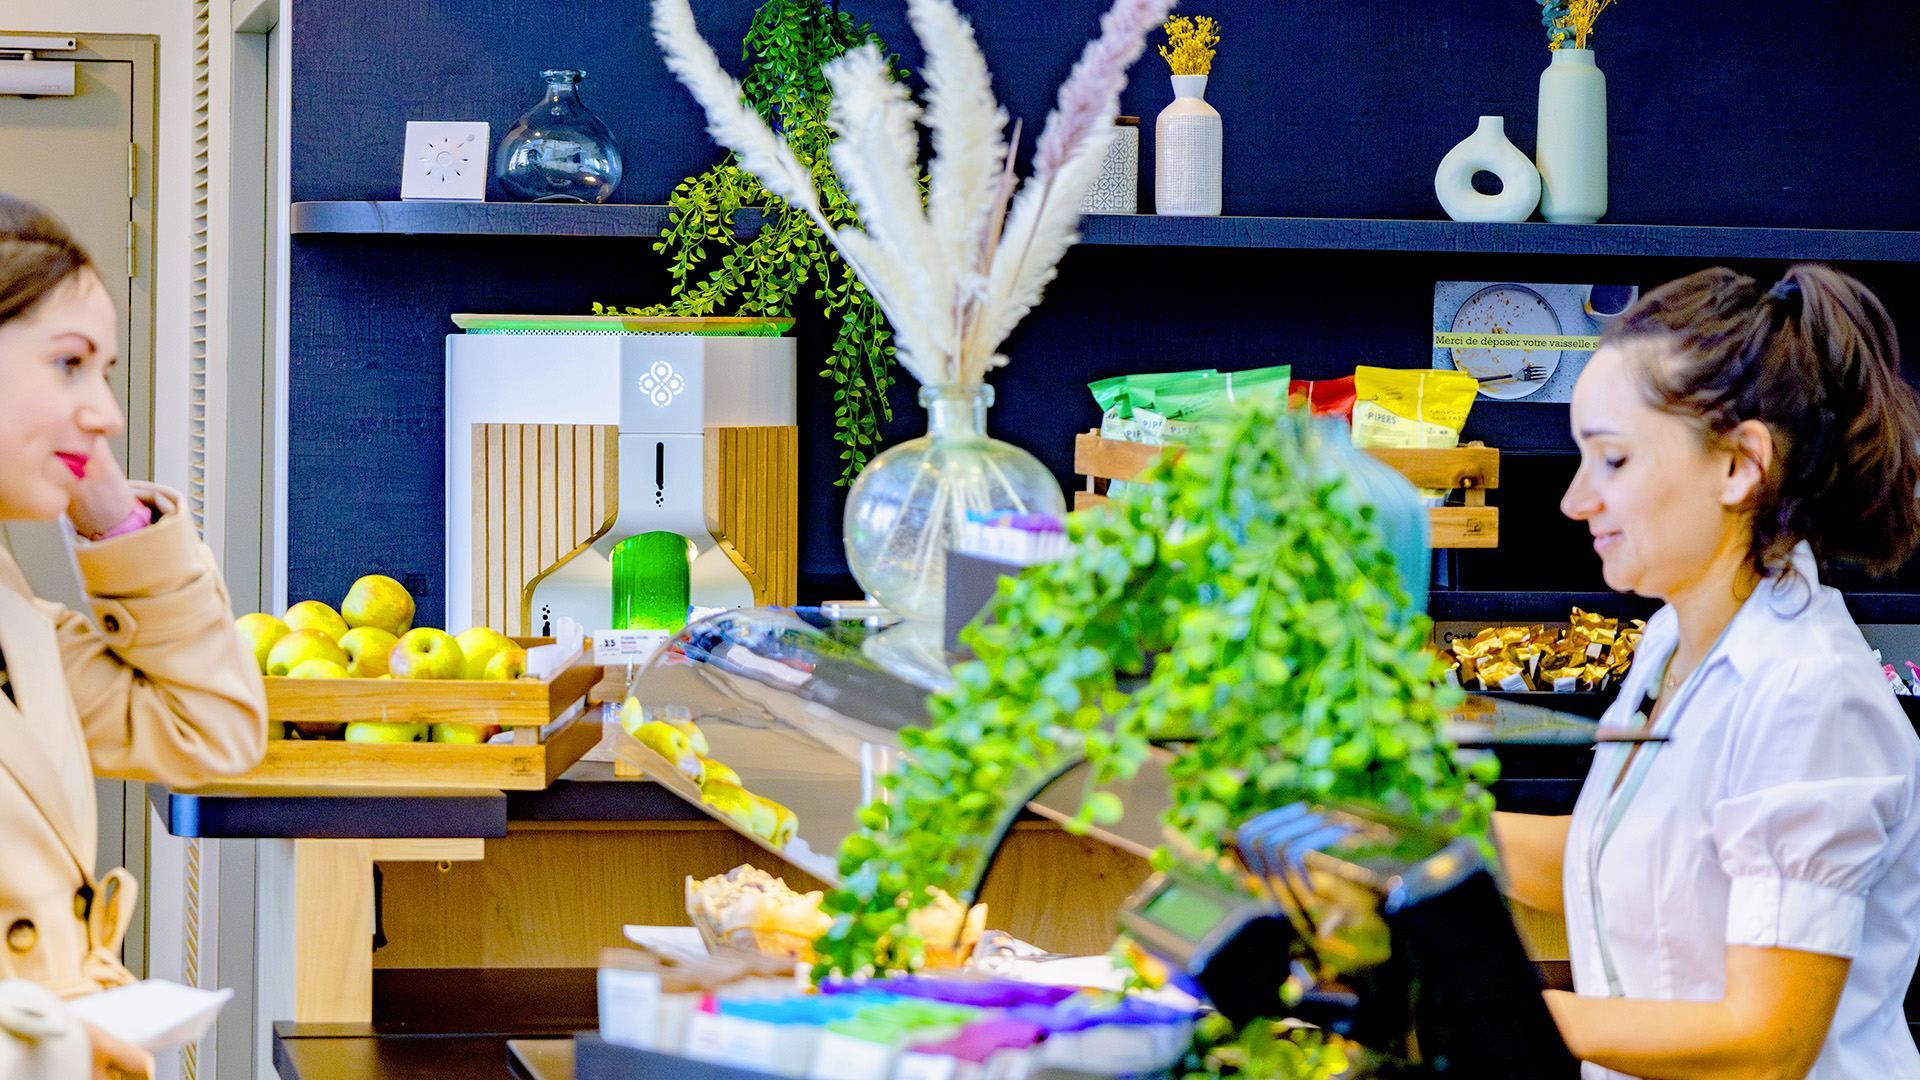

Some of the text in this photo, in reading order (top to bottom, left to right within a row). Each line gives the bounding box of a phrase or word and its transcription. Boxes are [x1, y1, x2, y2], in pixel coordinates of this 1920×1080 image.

[1435, 335, 1463, 345] Merci
[1465, 336, 1478, 346] de
[1480, 336, 1520, 348] déposer
[1523, 339, 1547, 348] votre
[1549, 339, 1591, 349] vaisselle
[1367, 411, 1397, 424] PIPERS
